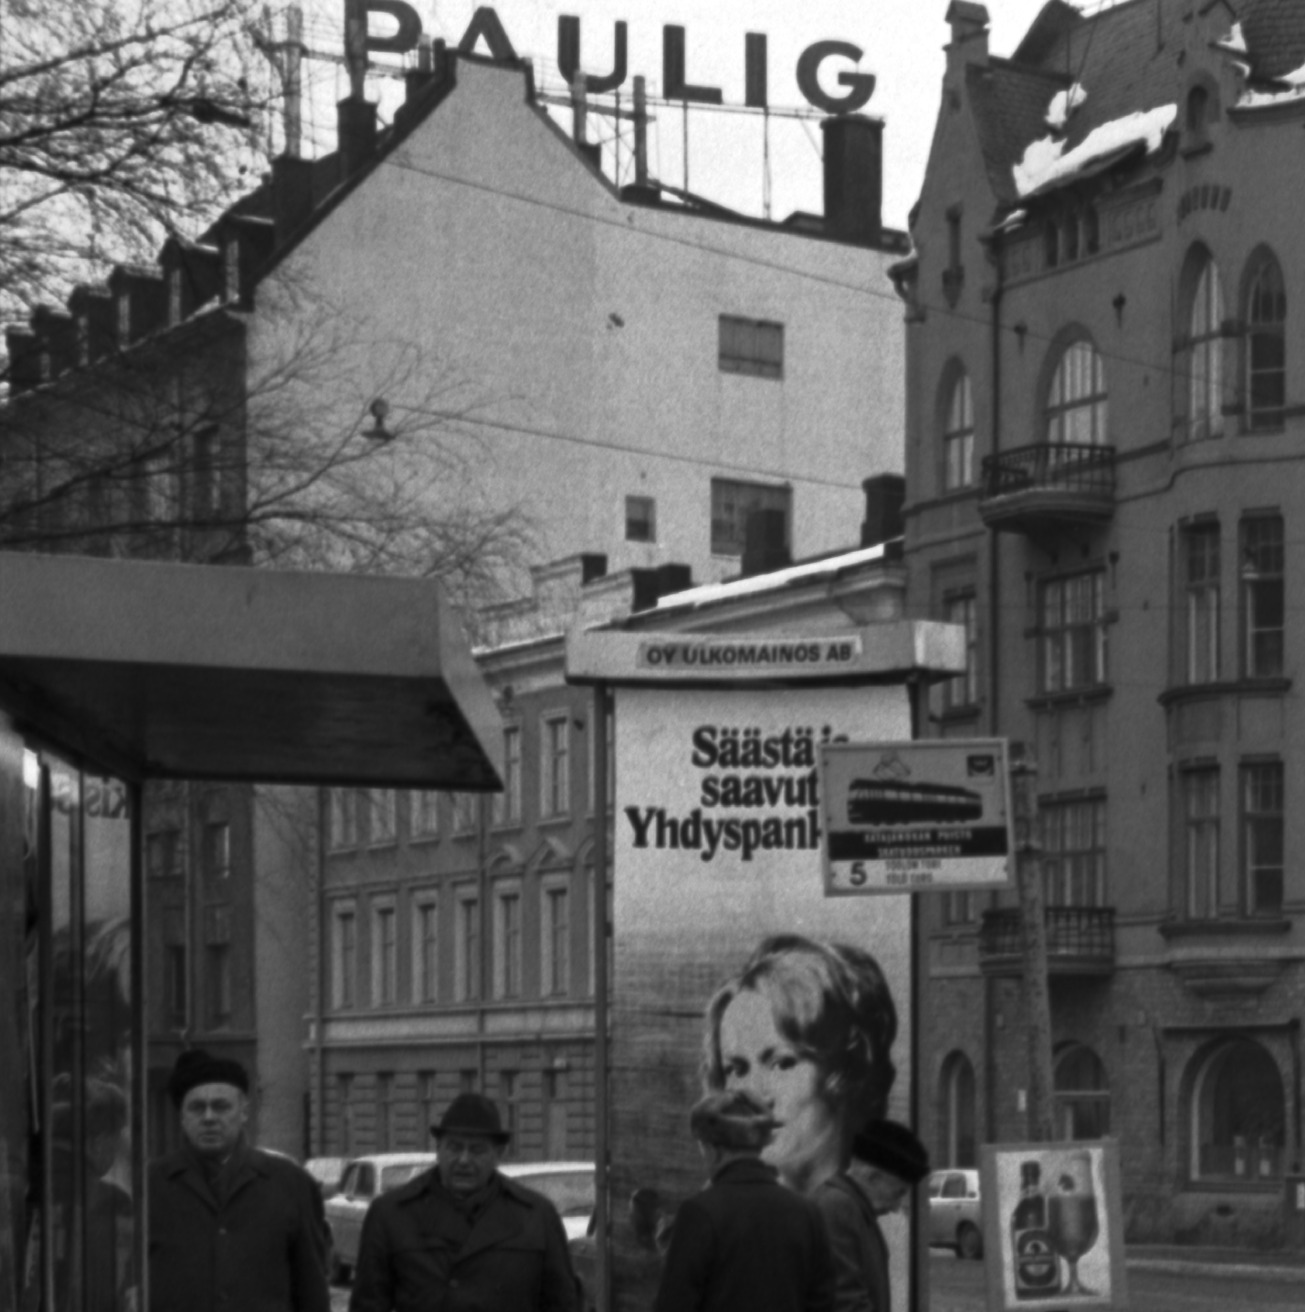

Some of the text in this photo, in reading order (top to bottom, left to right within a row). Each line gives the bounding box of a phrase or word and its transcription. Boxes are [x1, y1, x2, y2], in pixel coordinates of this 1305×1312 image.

[344, 0, 877, 114] PAULIG
[646, 642, 853, 665] OY ULKOMAINOS AB
[691, 724, 815, 768] Säästä
[700, 767, 820, 807] saavut
[849, 860, 867, 886] 5
